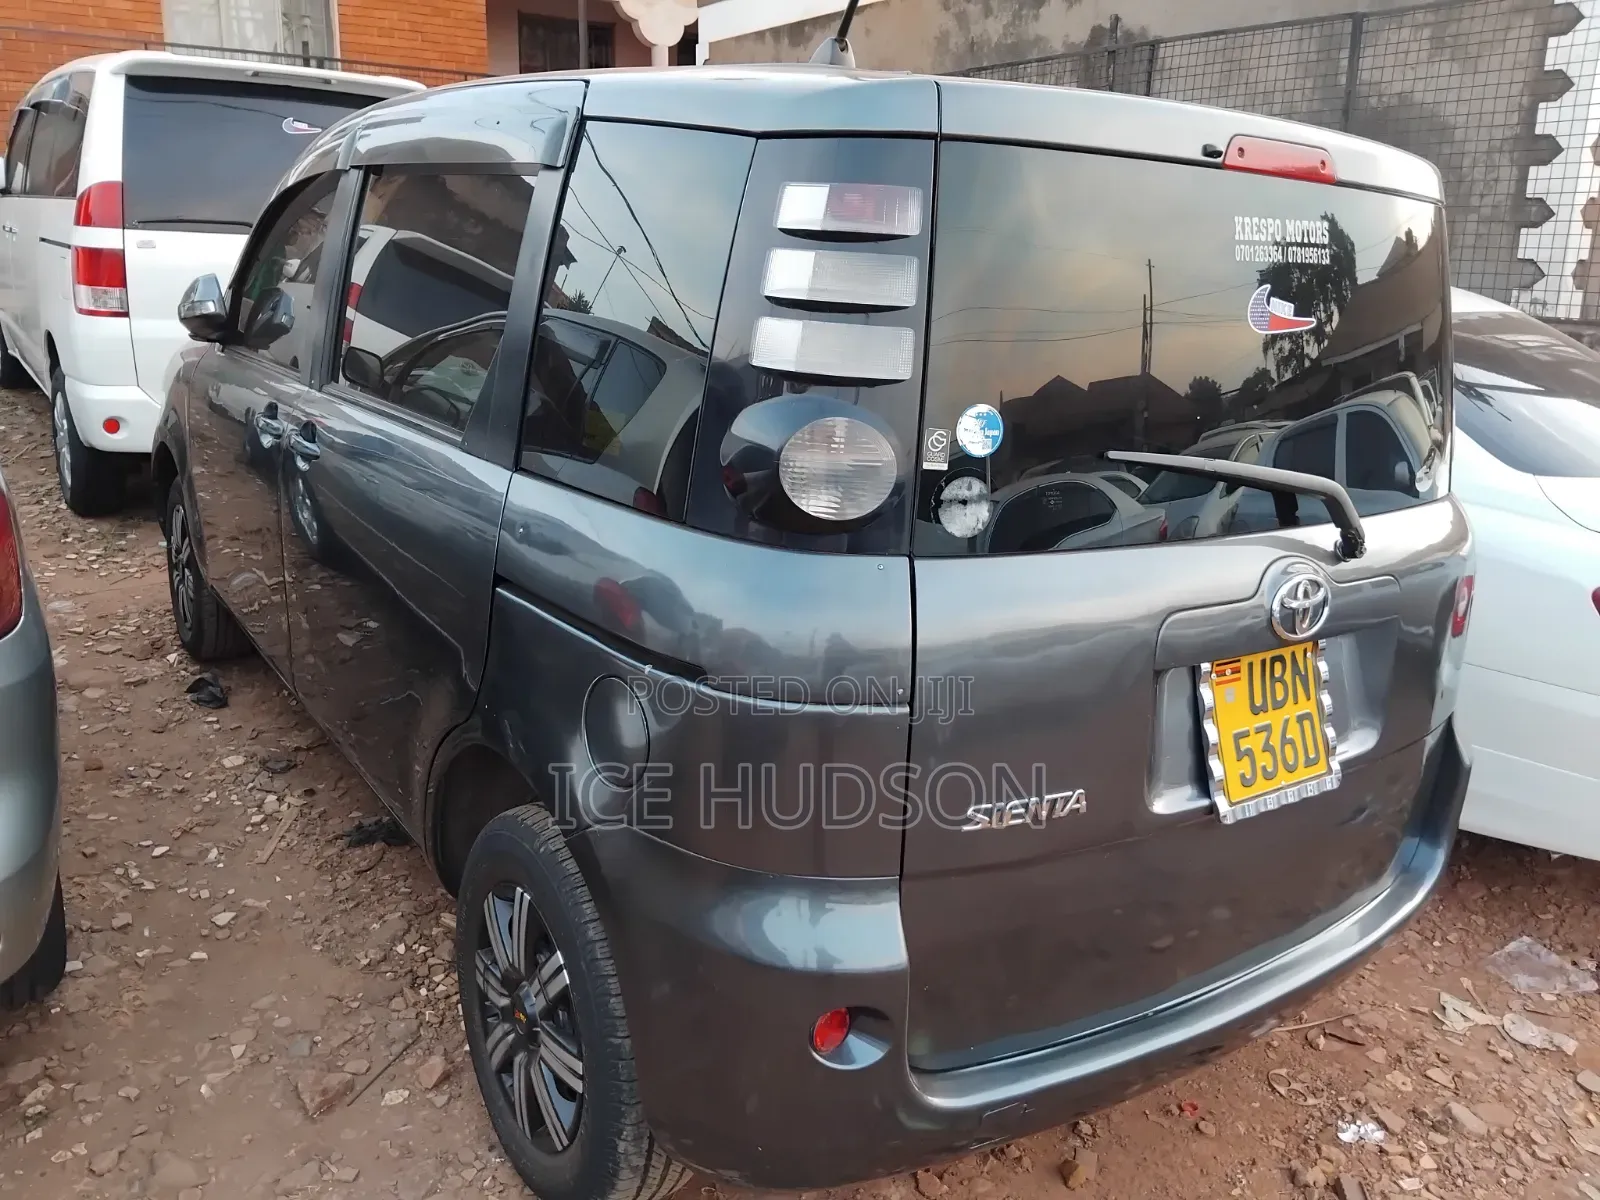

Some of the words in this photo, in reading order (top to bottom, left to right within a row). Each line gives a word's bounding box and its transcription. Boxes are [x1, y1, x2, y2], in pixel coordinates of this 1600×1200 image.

[1234, 215, 1281, 241] KRESPO
[1286, 219, 1329, 244] MOTORS
[1247, 646, 1311, 716] UBN
[1232, 709, 1321, 788] 536D
[961, 788, 1087, 832] SIENTA
